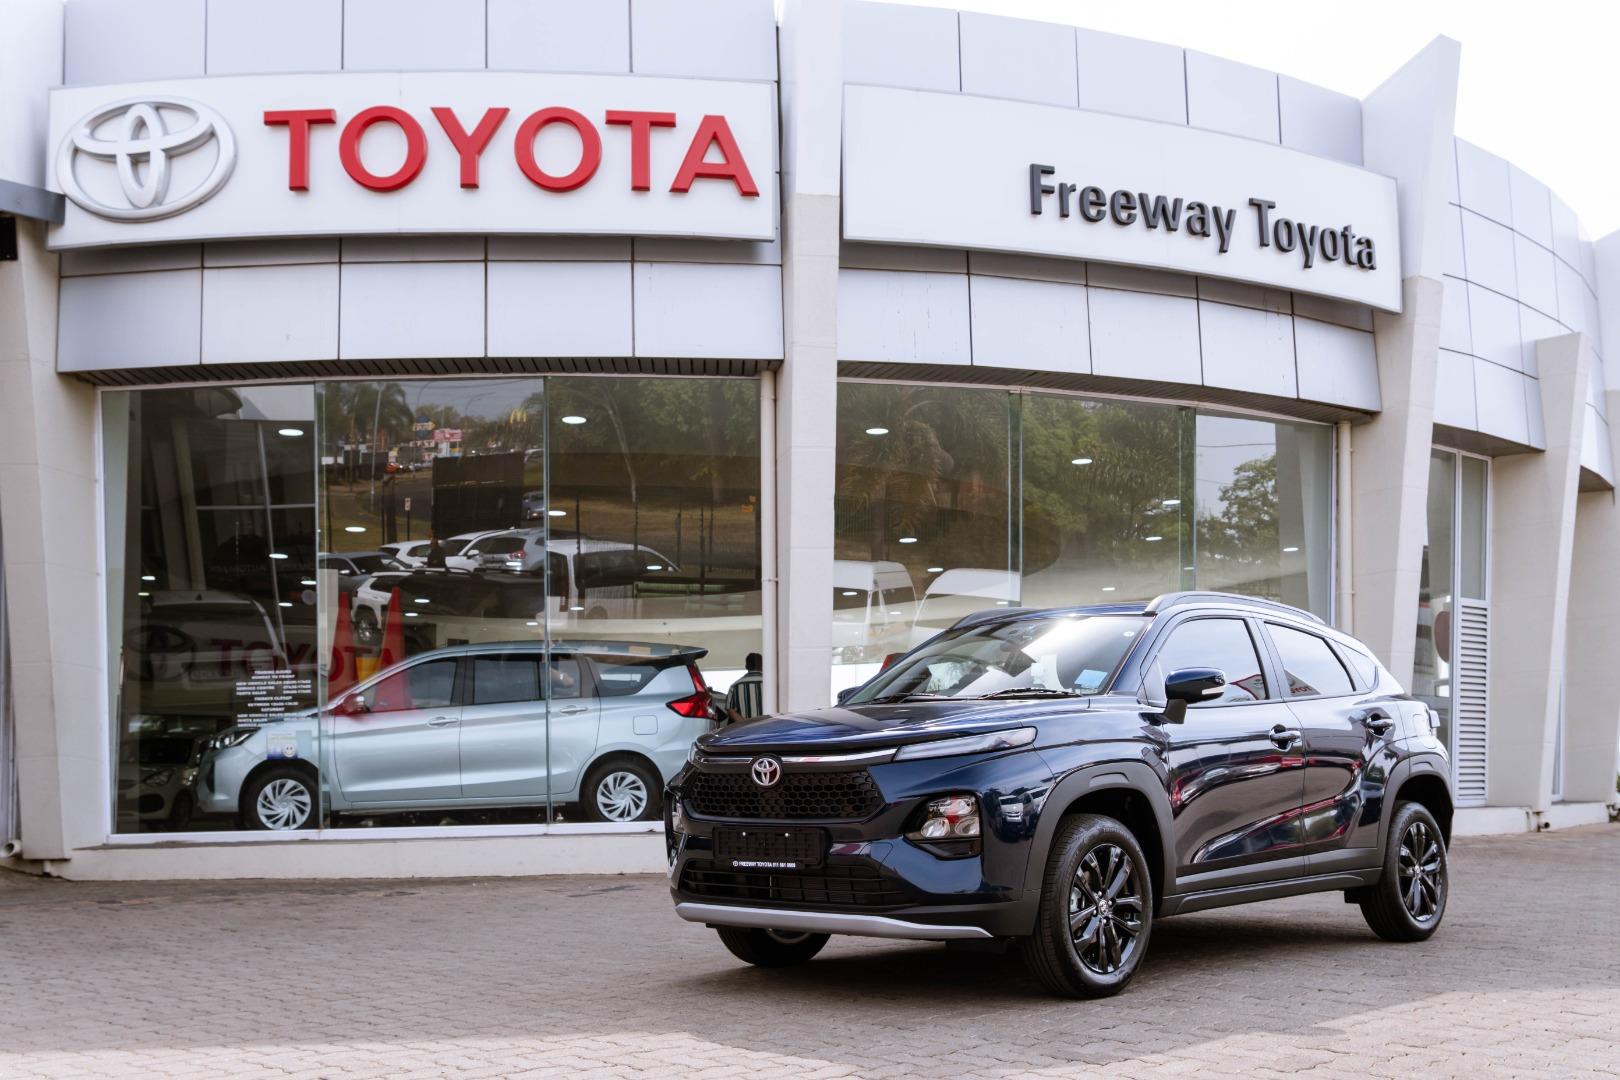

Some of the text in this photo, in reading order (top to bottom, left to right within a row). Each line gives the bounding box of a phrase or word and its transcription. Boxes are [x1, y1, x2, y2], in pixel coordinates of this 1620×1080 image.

[263, 104, 759, 198] TOYOTA
[1029, 163, 1377, 271] Freeway Toyota
